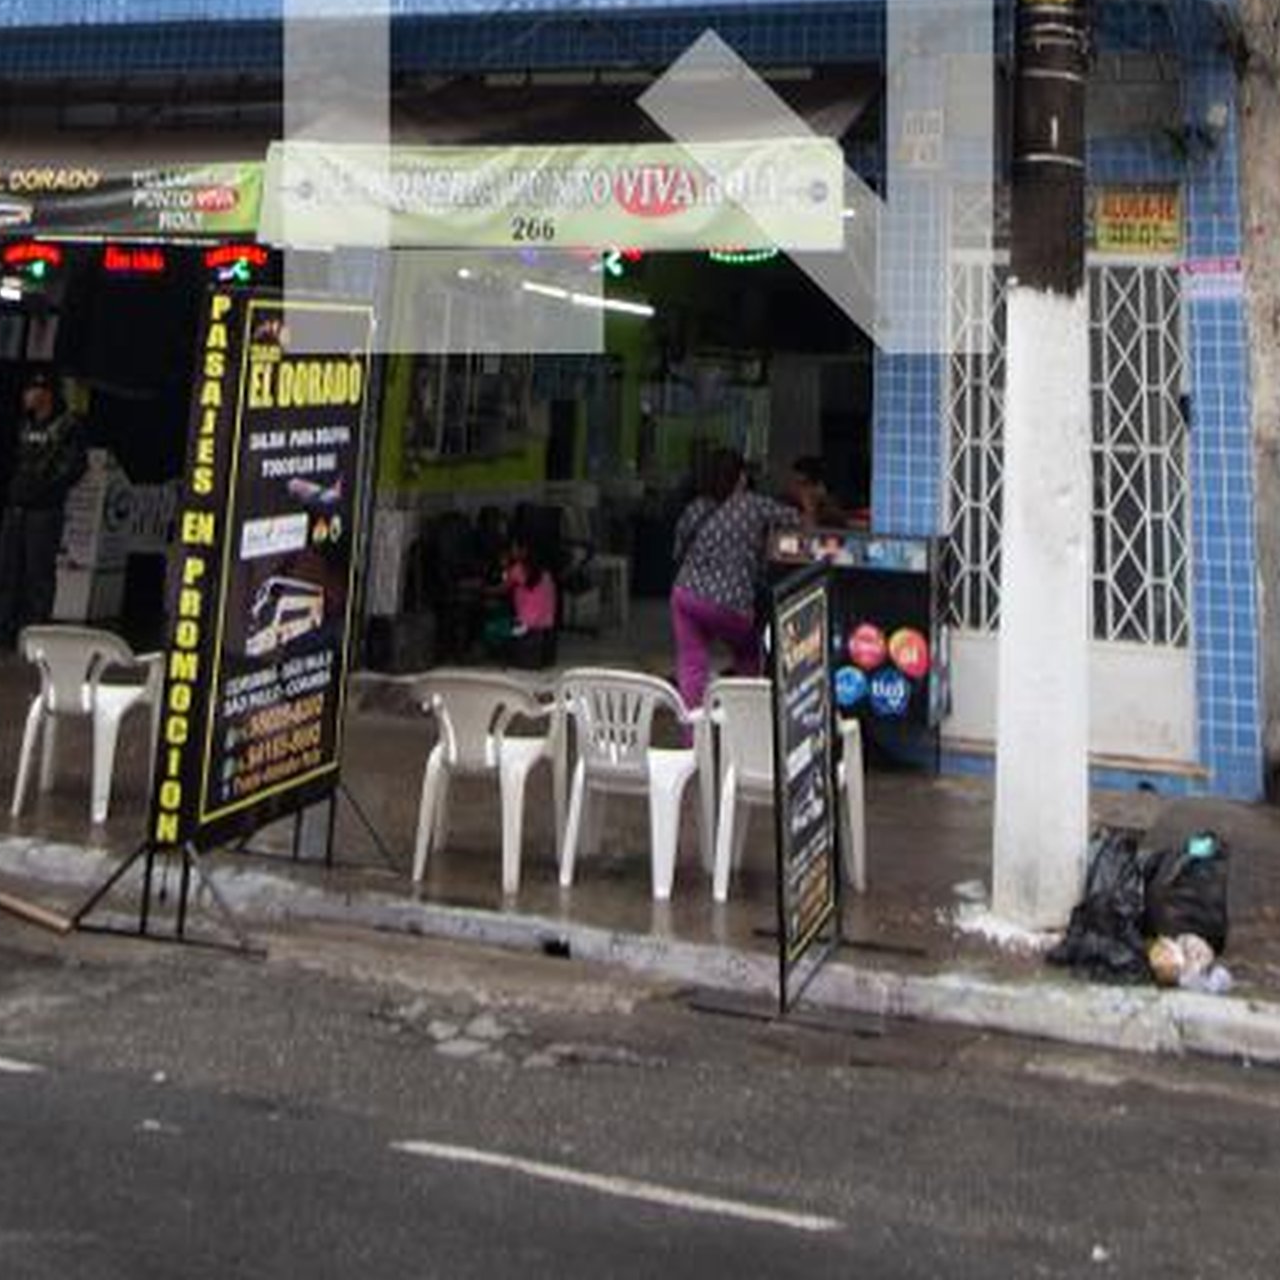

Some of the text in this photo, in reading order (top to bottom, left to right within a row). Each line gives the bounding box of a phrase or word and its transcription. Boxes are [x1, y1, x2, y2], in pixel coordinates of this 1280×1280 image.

[9, 166, 100, 191] DORADO
[619, 165, 697, 207] VIVA
[511, 217, 555, 241] 266
[191, 295, 233, 496] PASAJES
[249, 360, 363, 409] EL DORADO
[181, 512, 215, 546] EN
